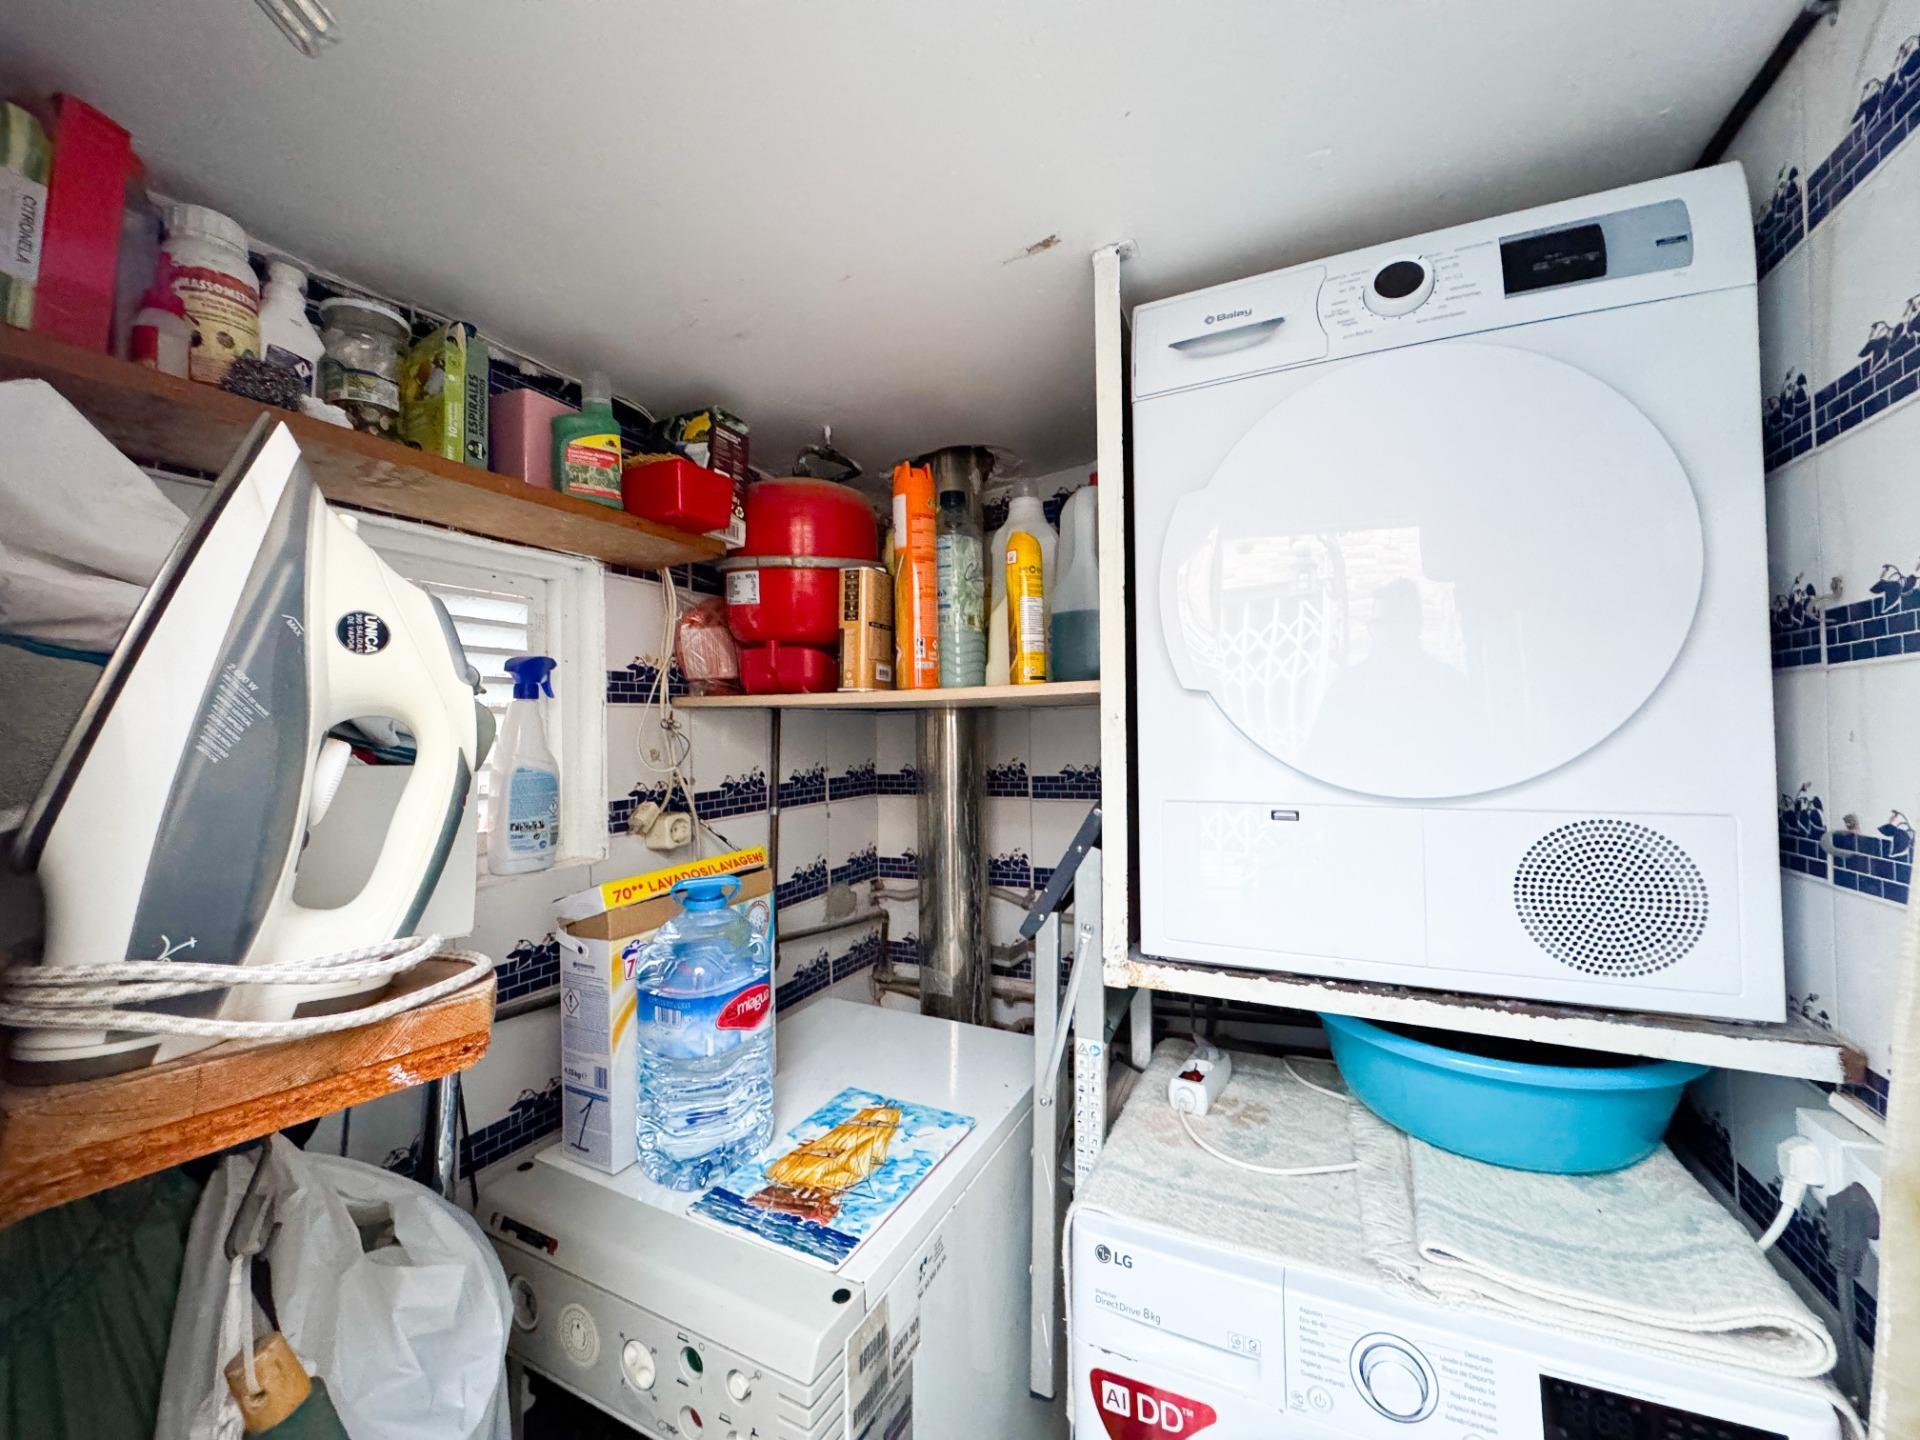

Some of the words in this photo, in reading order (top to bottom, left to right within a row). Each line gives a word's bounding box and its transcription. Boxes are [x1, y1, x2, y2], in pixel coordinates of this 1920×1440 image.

[16, 194, 38, 264] CITRONELA
[1216, 307, 1253, 322] Balay
[467, 373, 480, 436] ESPIRALES
[286, 619, 303, 637] MAX
[347, 615, 355, 625] DE
[347, 626, 355, 649] VAPOR
[356, 625, 364, 654] SALIDAS
[364, 615, 381, 653] ÚNICA
[1114, 1251, 1133, 1269] LG
[1105, 1381, 1129, 1410] AI
